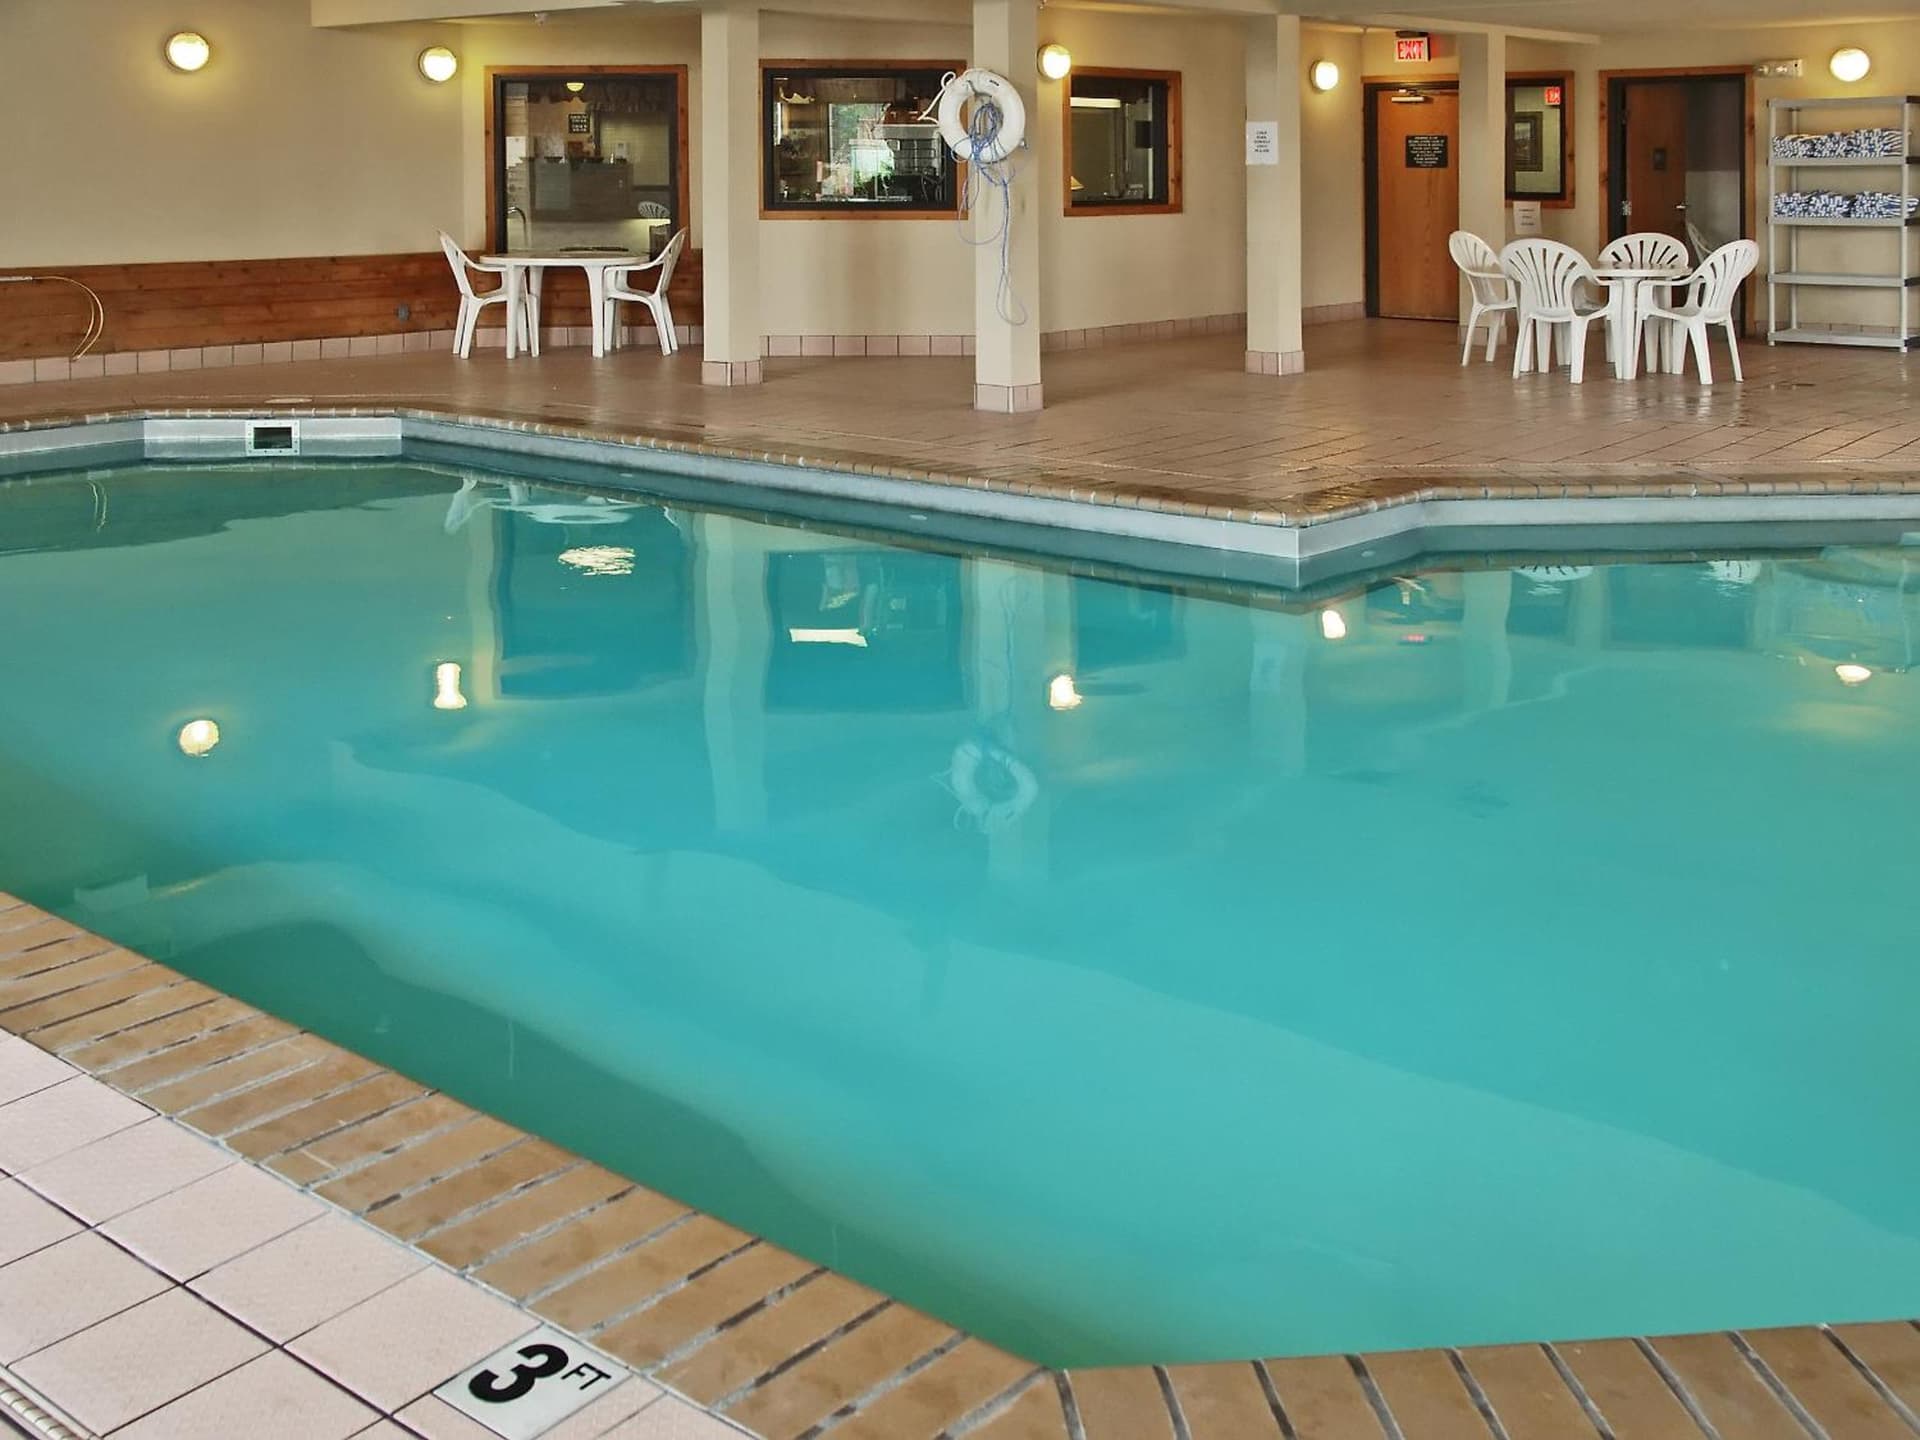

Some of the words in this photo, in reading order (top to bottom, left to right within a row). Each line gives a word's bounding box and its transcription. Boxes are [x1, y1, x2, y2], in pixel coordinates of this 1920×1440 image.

[1397, 40, 1423, 60] EXIT
[468, 1343, 569, 1403] 3
[560, 1362, 612, 1390] FT
